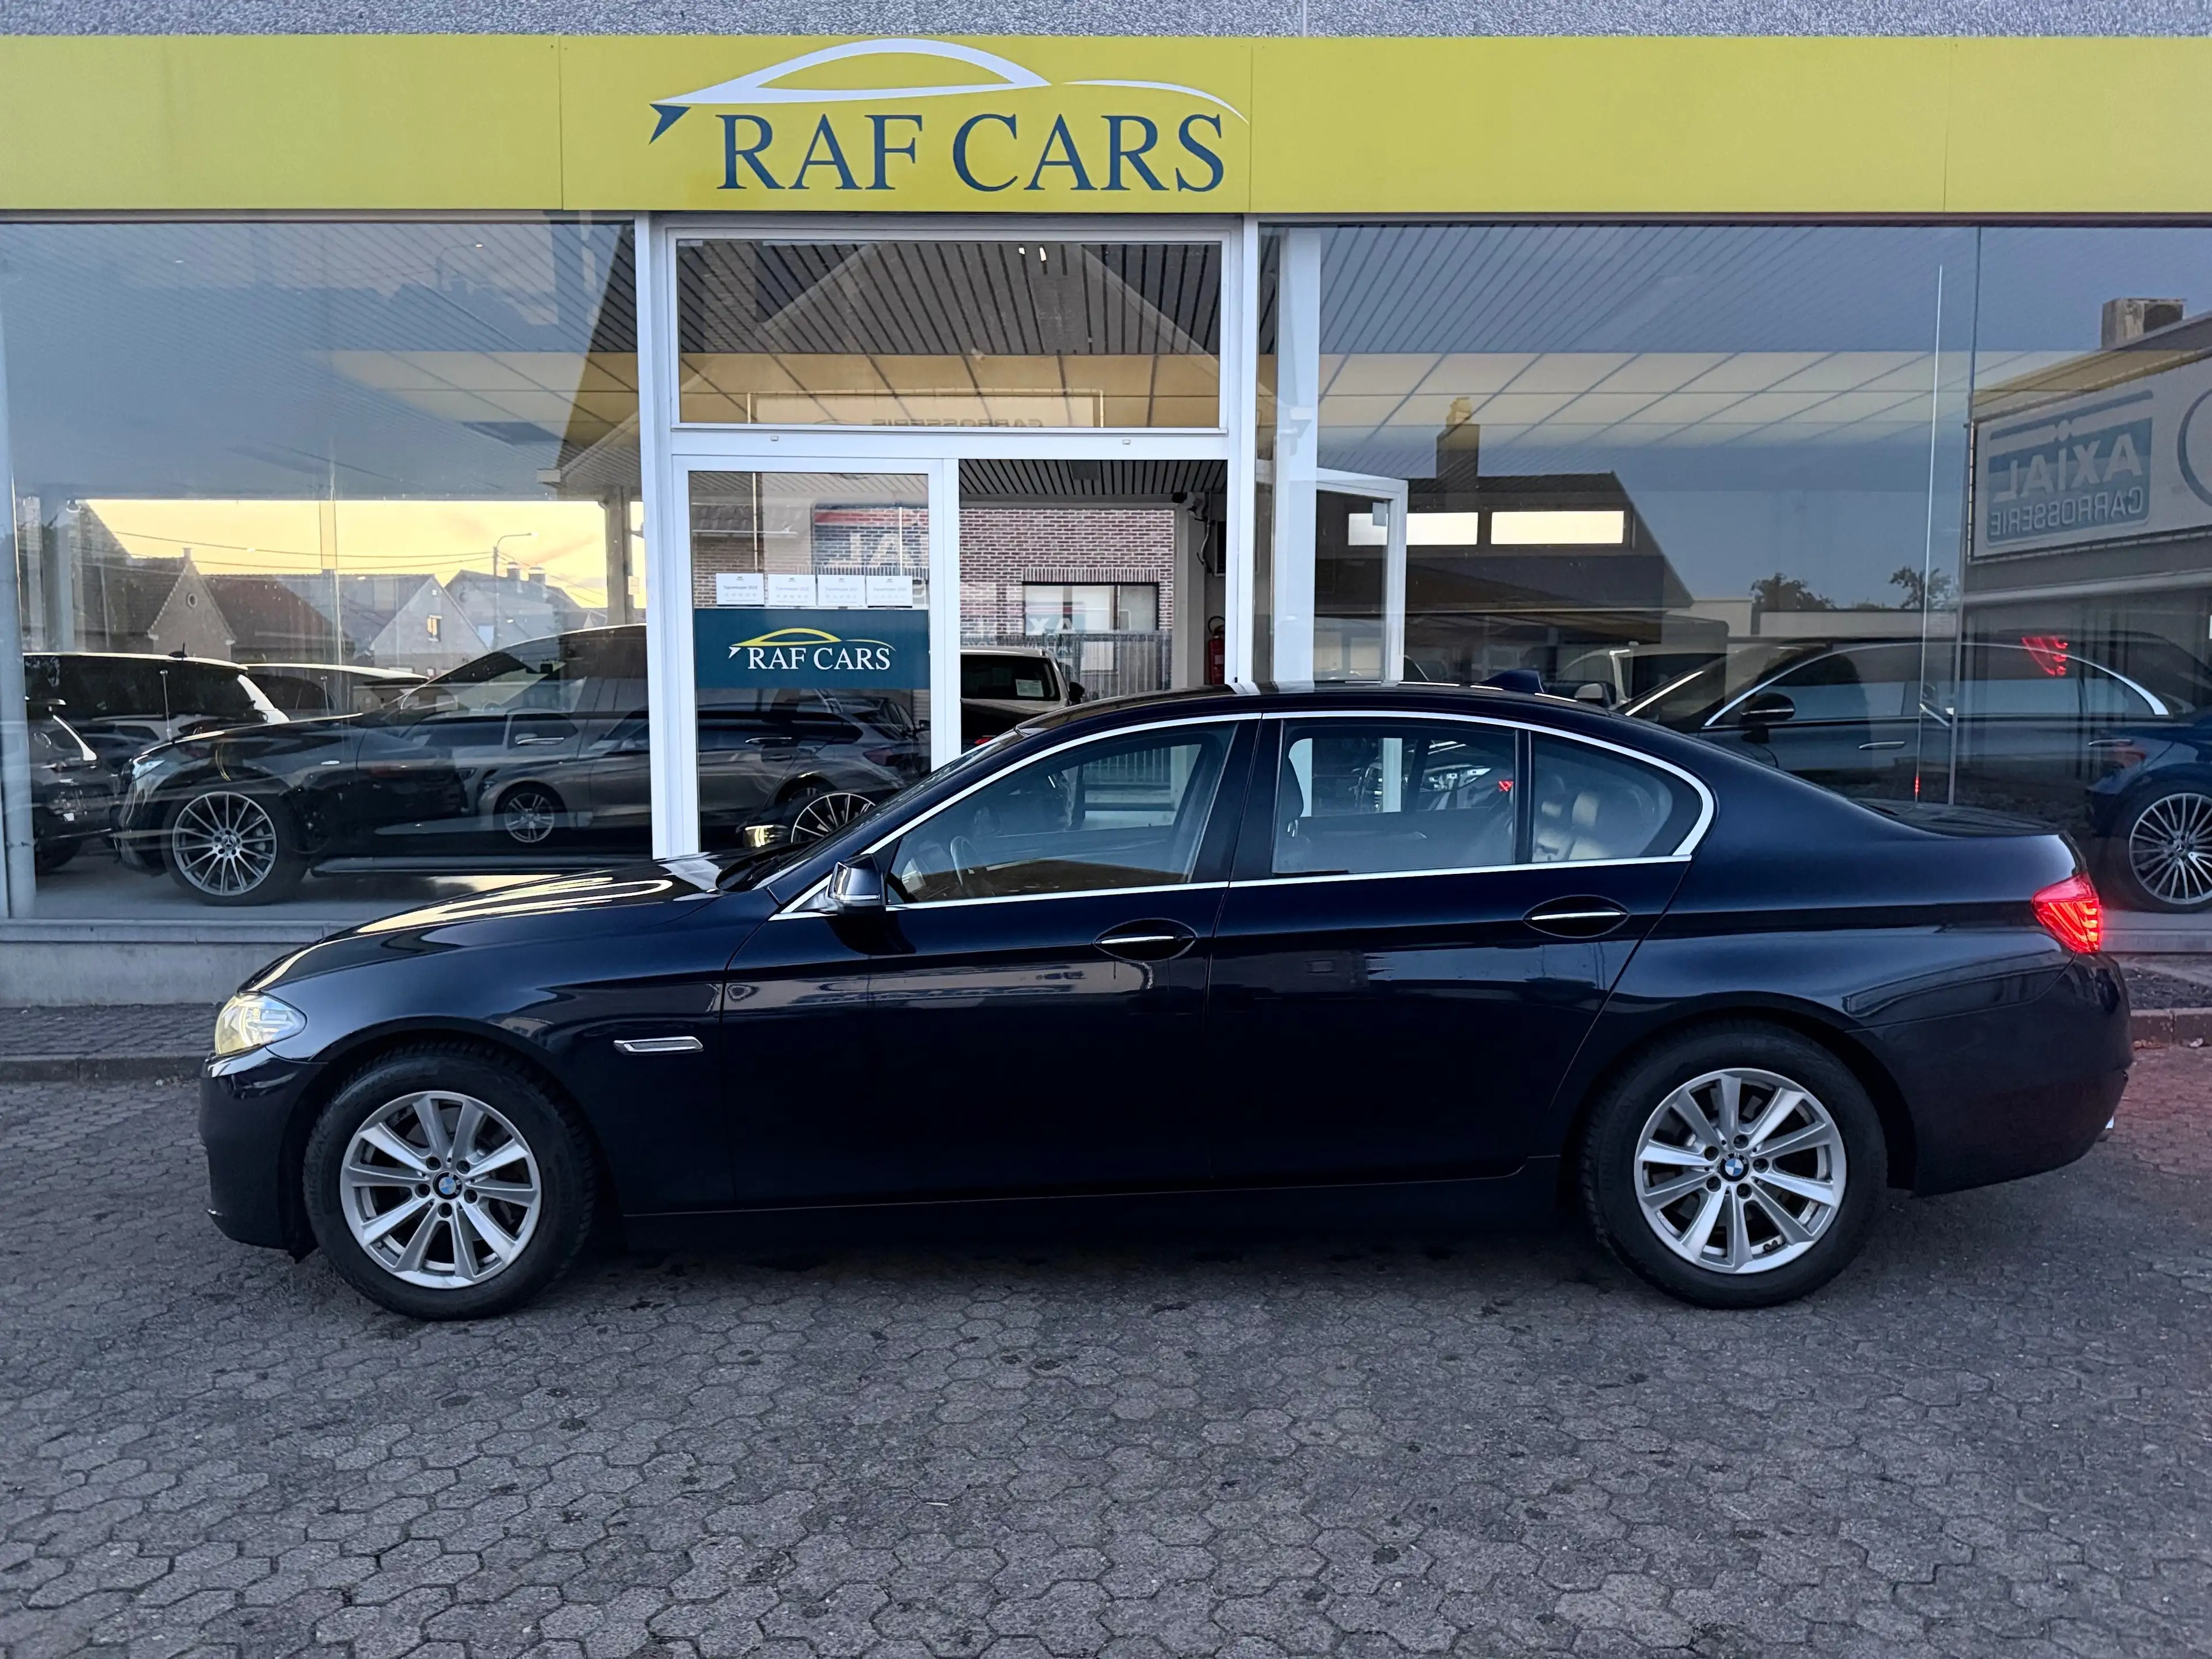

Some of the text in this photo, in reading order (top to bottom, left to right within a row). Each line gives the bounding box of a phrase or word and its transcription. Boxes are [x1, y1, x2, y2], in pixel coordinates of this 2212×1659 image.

[716, 113, 1224, 191] RAF CARS
[747, 647, 891, 671] RAF CARS
